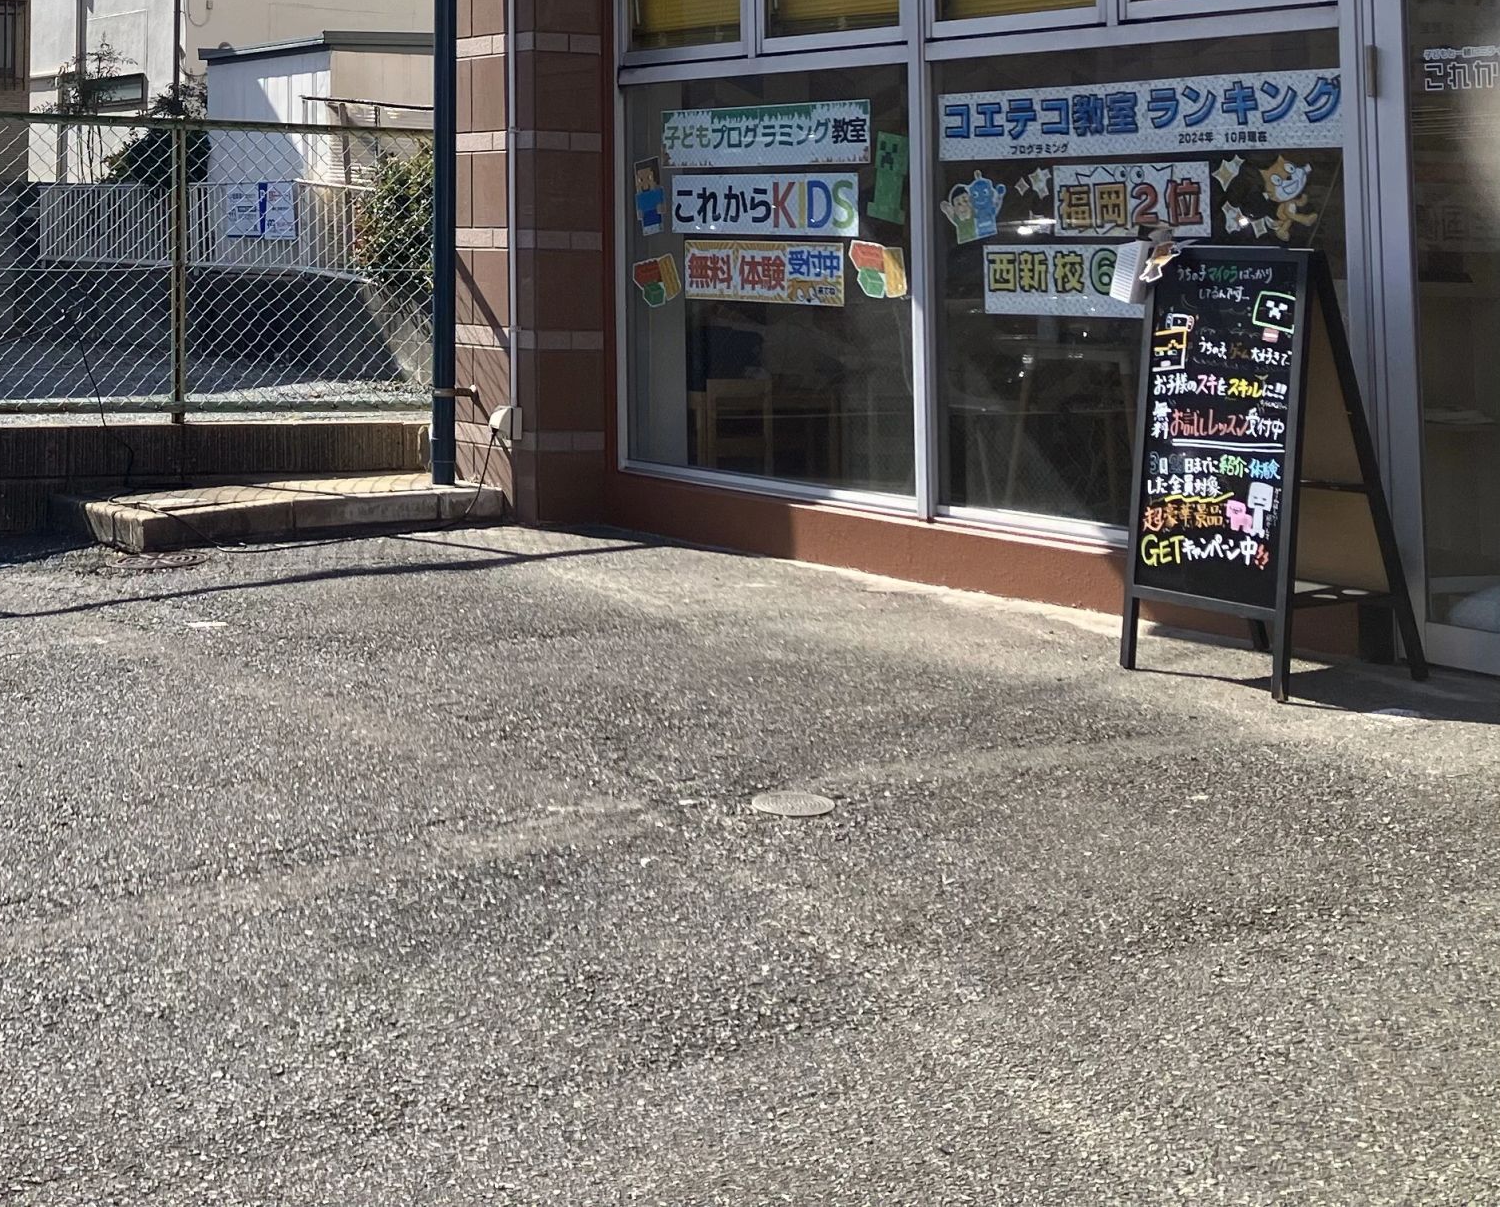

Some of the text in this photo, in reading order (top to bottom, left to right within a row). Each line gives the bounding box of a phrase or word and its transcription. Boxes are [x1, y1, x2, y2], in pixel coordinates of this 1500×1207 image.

[664, 117, 868, 150] 子どもプログラミング教室
[1010, 143, 1069, 155] プログラミング
[674, 180, 854, 229] これからKIDS
[1057, 178, 1203, 232] 福岡2位
